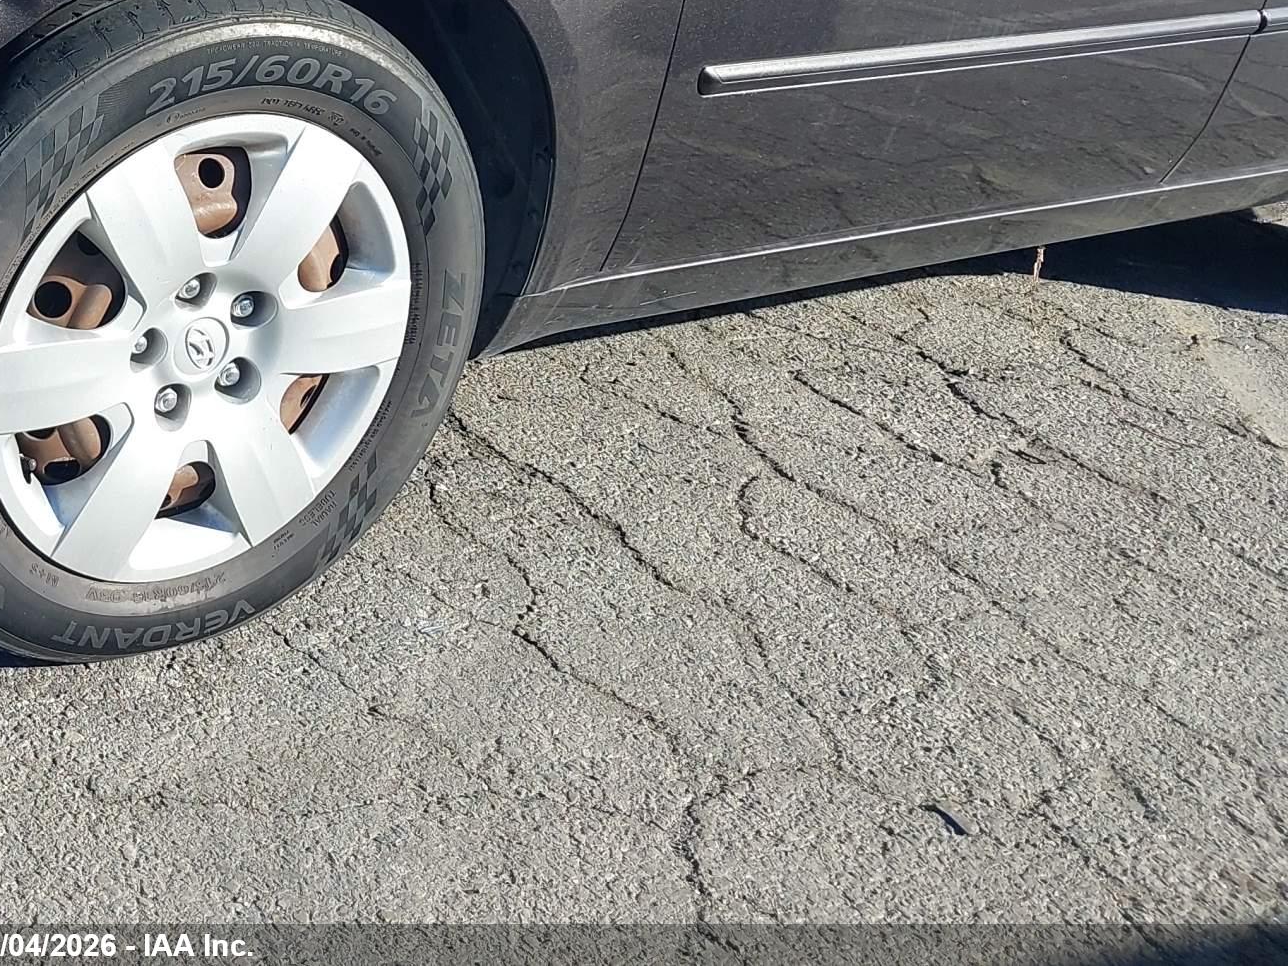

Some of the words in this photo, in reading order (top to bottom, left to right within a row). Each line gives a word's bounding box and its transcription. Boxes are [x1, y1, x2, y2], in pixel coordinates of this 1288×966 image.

[145, 53, 397, 116] 215/60R16
[410, 267, 468, 419] ZETA
[49, 599, 256, 650] VERDANT
